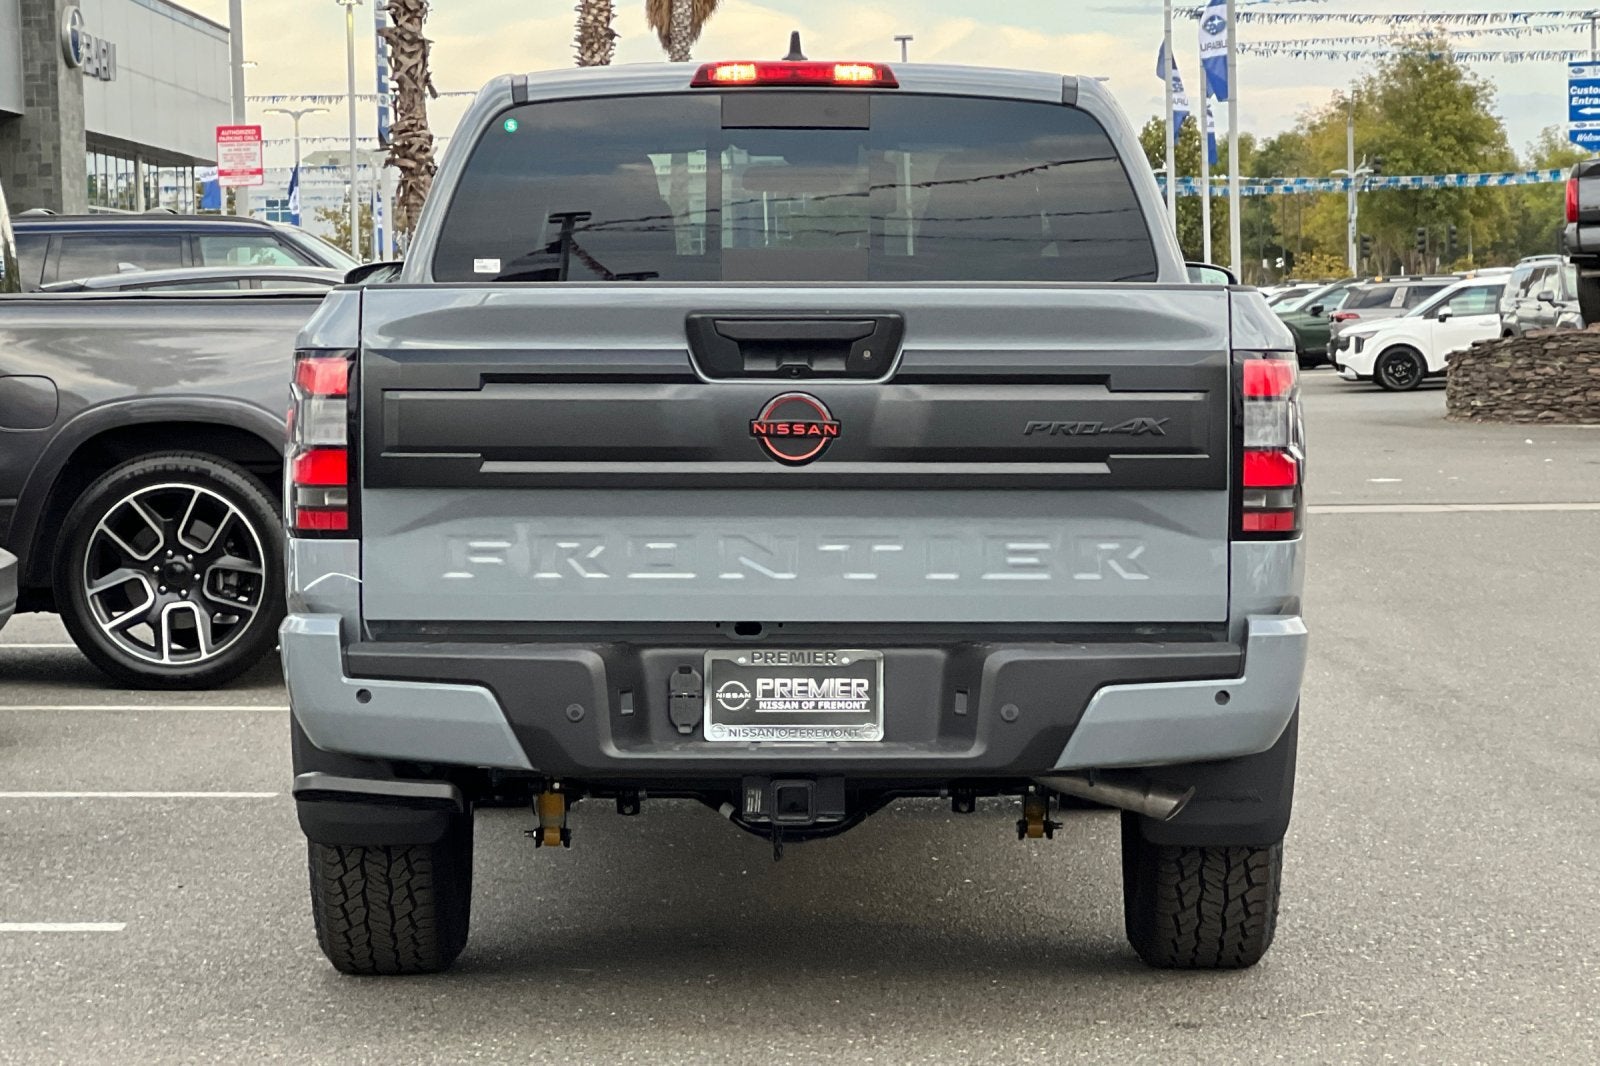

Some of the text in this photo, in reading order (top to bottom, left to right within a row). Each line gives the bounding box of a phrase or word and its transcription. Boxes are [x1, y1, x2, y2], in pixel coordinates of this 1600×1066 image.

[1570, 86, 1600, 95] Custo
[1571, 97, 1600, 105] Entra
[753, 423, 837, 435] NISSAN
[1023, 417, 1170, 436] PRO-4X
[442, 533, 1151, 579] FRONTIER
[751, 651, 837, 665] PREMIER
[756, 678, 870, 699] PREMIER
[759, 700, 867, 710] NISSAN OF FREMONT
[728, 728, 860, 738] NISSAN OF FREMONT
